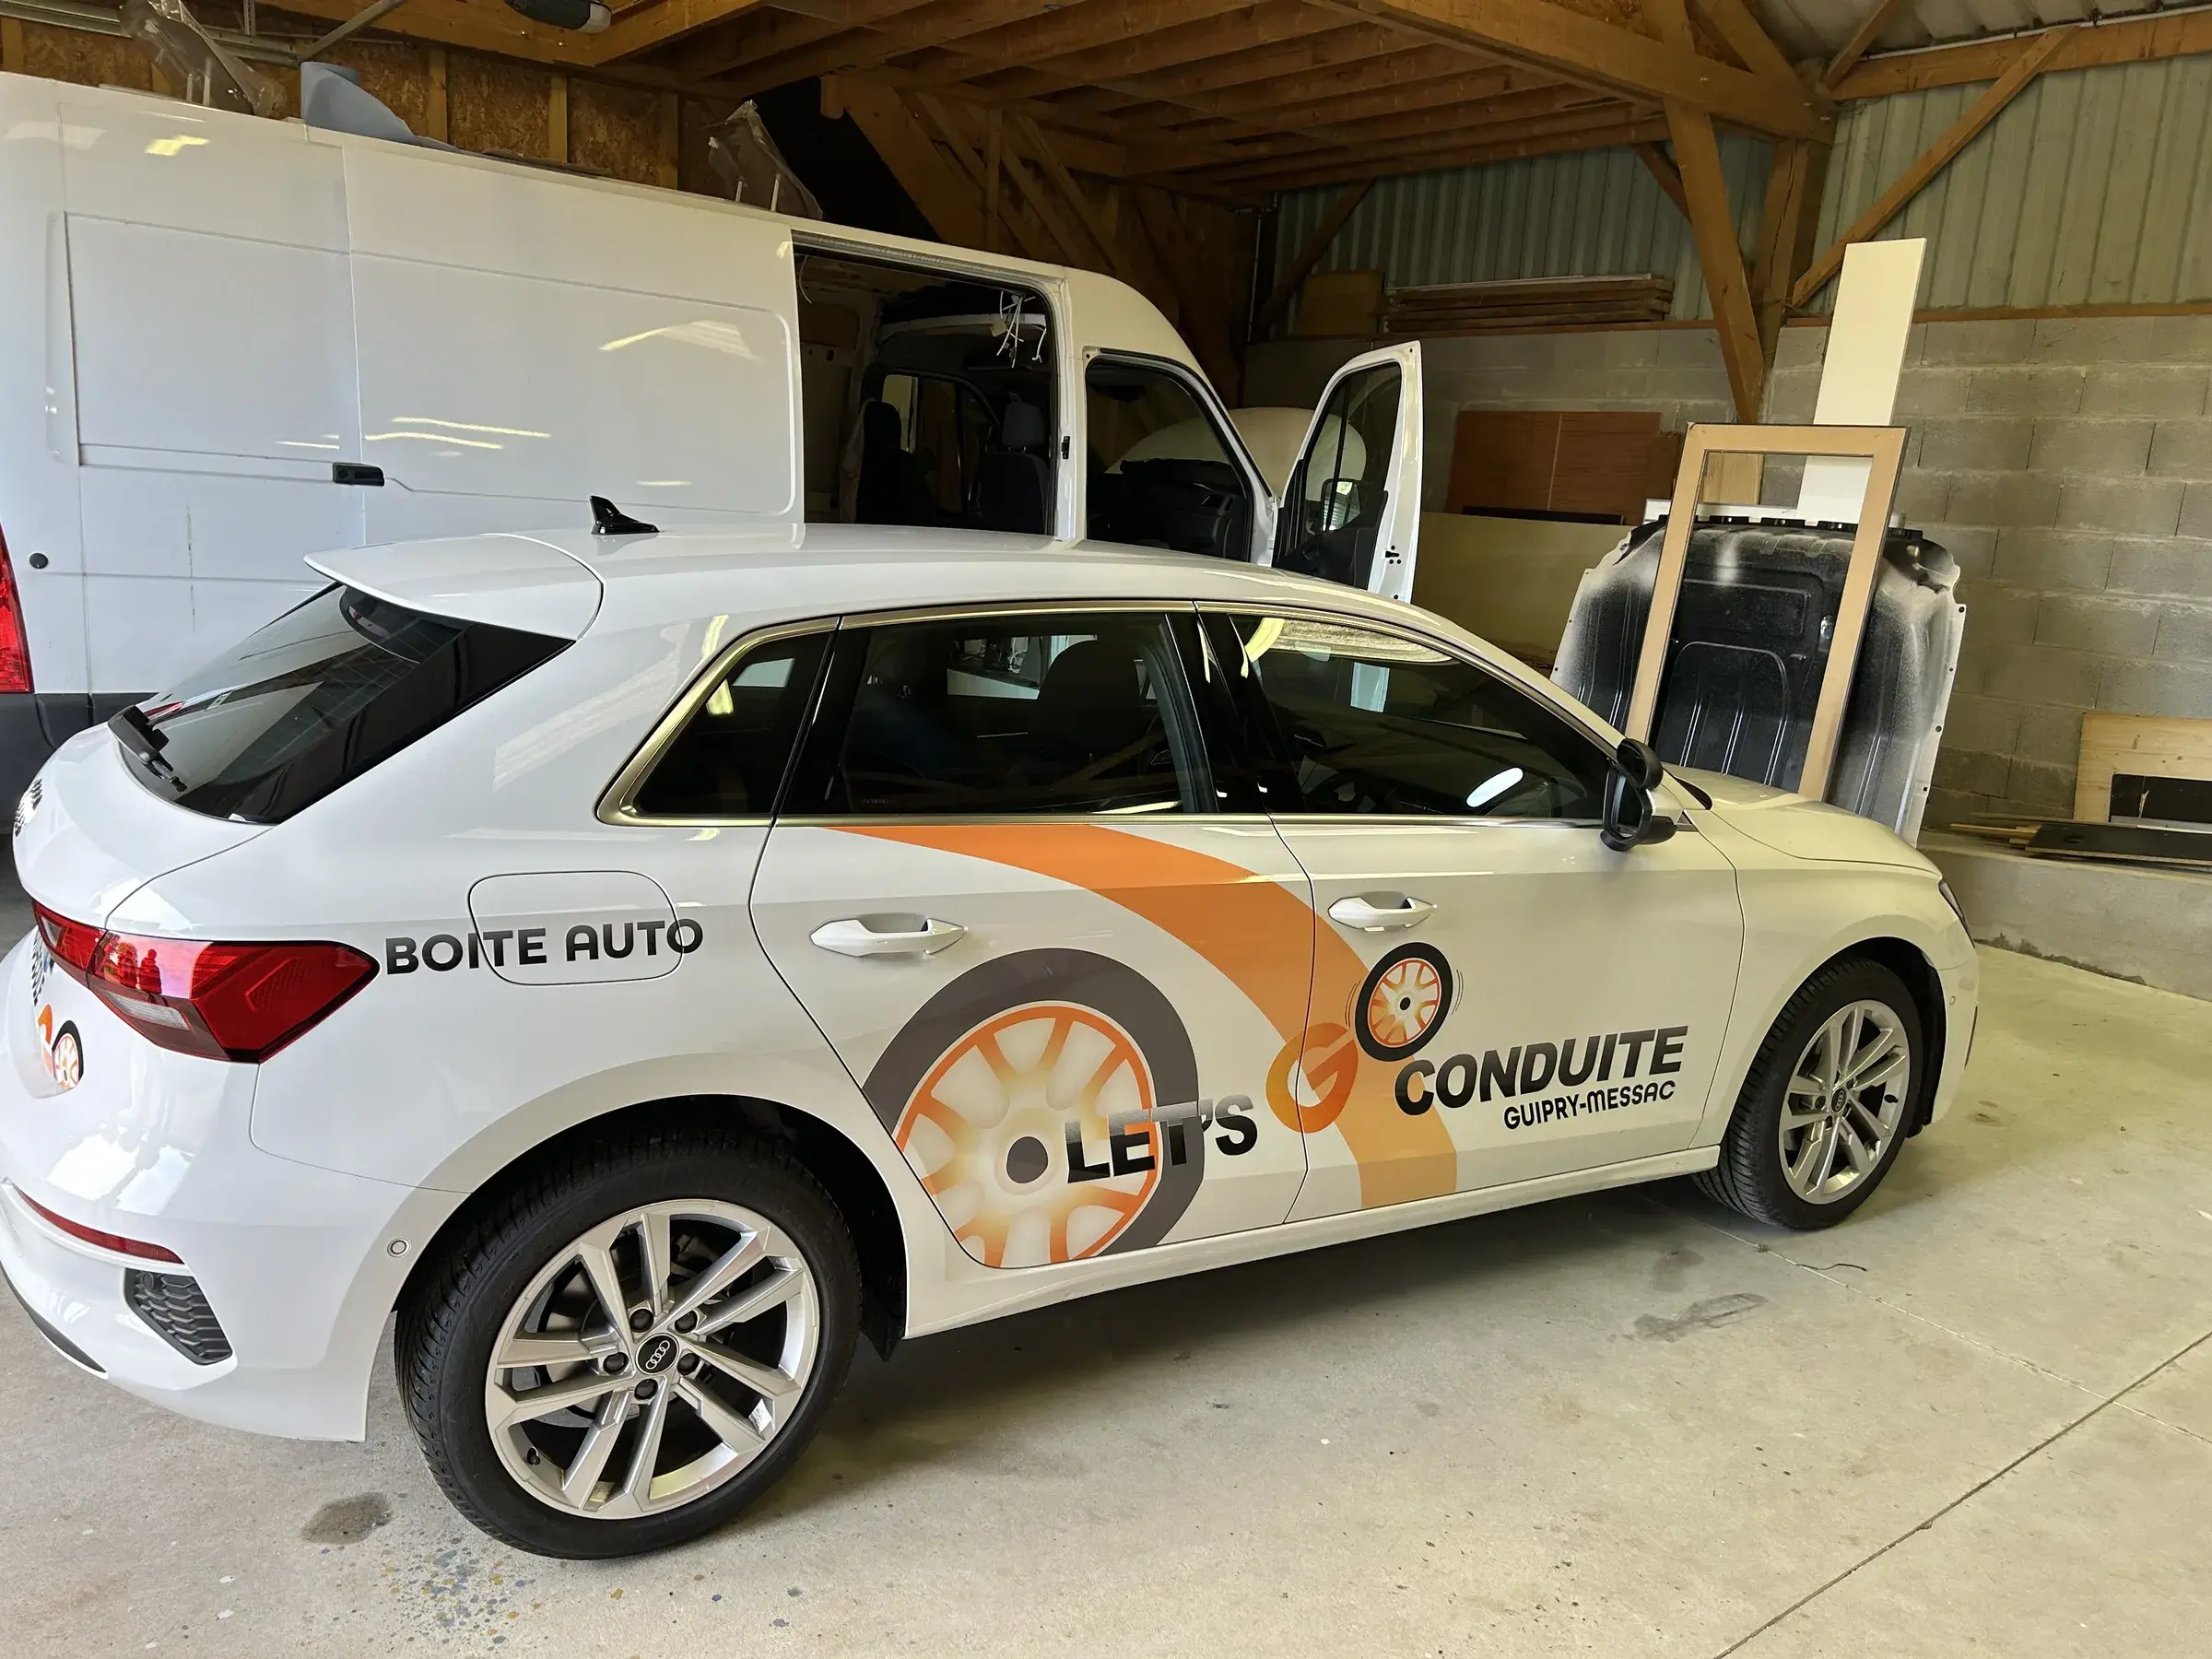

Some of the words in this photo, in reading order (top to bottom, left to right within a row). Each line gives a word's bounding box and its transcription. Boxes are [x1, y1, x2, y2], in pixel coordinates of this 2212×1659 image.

[385, 927, 547, 975] BOITE
[565, 918, 703, 962] AUTO
[1394, 1026, 1688, 1116] CONDUITE
[1504, 1080, 1676, 1130] GUIPRY-MESSAC
[1065, 1094, 1258, 1183] LET'S
